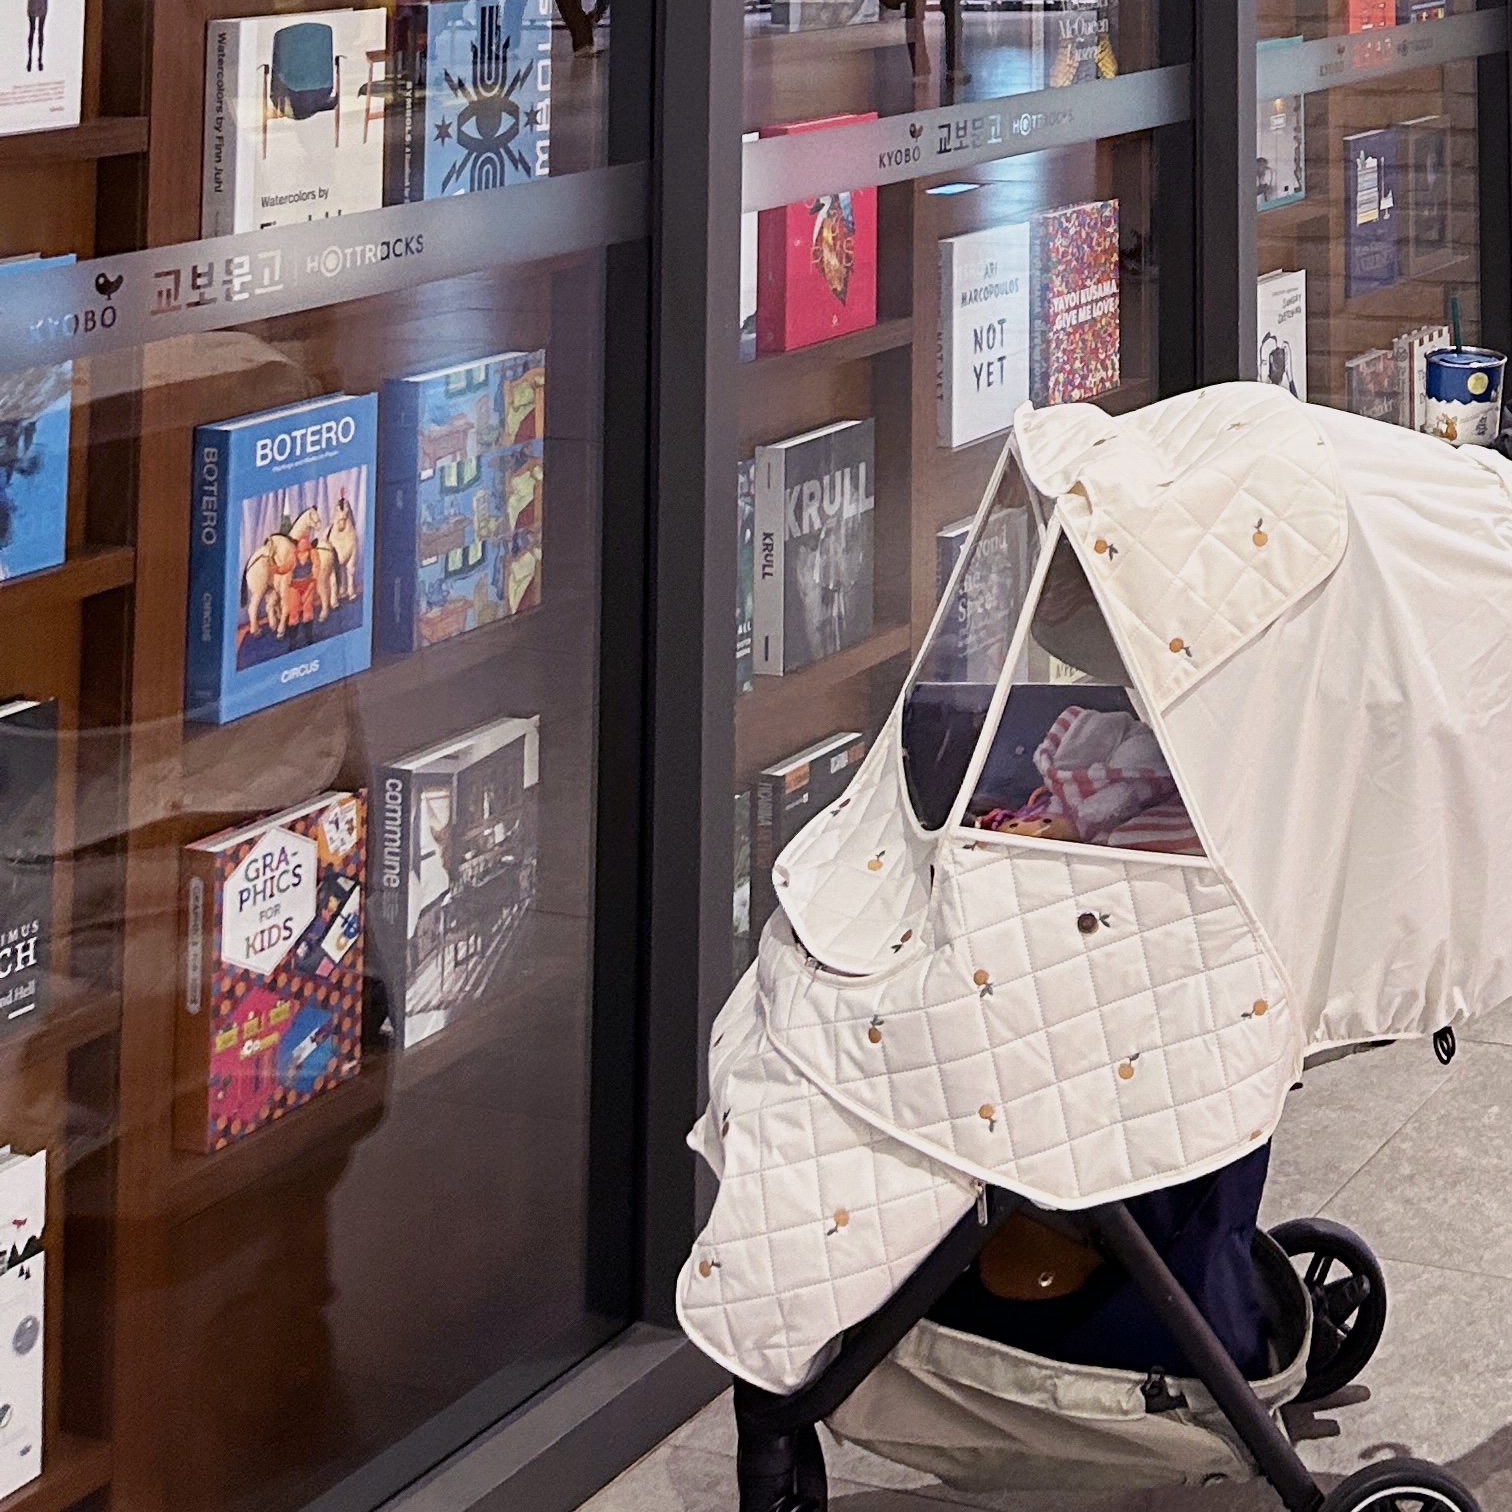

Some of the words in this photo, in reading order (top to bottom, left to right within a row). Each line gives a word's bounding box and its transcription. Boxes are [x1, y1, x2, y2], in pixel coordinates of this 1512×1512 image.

[216, 32, 227, 115] Watercolors
[215, 117, 225, 134] by
[936, 113, 1003, 155] 교보문고
[215, 136, 224, 161] Finn
[878, 145, 921, 169] KYOBO
[214, 163, 223, 193] Juhl
[261, 190, 316, 208] Watercolors
[319, 187, 329, 199] by
[150, 250, 285, 317] 교보문고
[984, 262, 998, 279] ARI
[960, 278, 1019, 308] MARCOPOULOS
[1052, 294, 1080, 313] YAYOI
[1081, 279, 1118, 308] KUSAMA
[29, 305, 117, 344] KYOBO
[1055, 312, 1077, 331] GIVE
[1078, 306, 1092, 323] ME
[1092, 298, 1116, 317] LOVE
[973, 318, 1006, 354] NOT
[973, 356, 1006, 392] YET
[256, 416, 355, 467] BOTERO
[202, 446, 218, 545] BOTERO
[784, 460, 875, 541] KRULL
[761, 532, 774, 580] KRULL
[281, 659, 320, 683] CIRCUS
[382, 778, 403, 888] commune
[244, 846, 299, 883] GRA-
[239, 863, 302, 912] PHICS
[260, 903, 281, 922] FOR
[245, 917, 293, 959] KIDS
